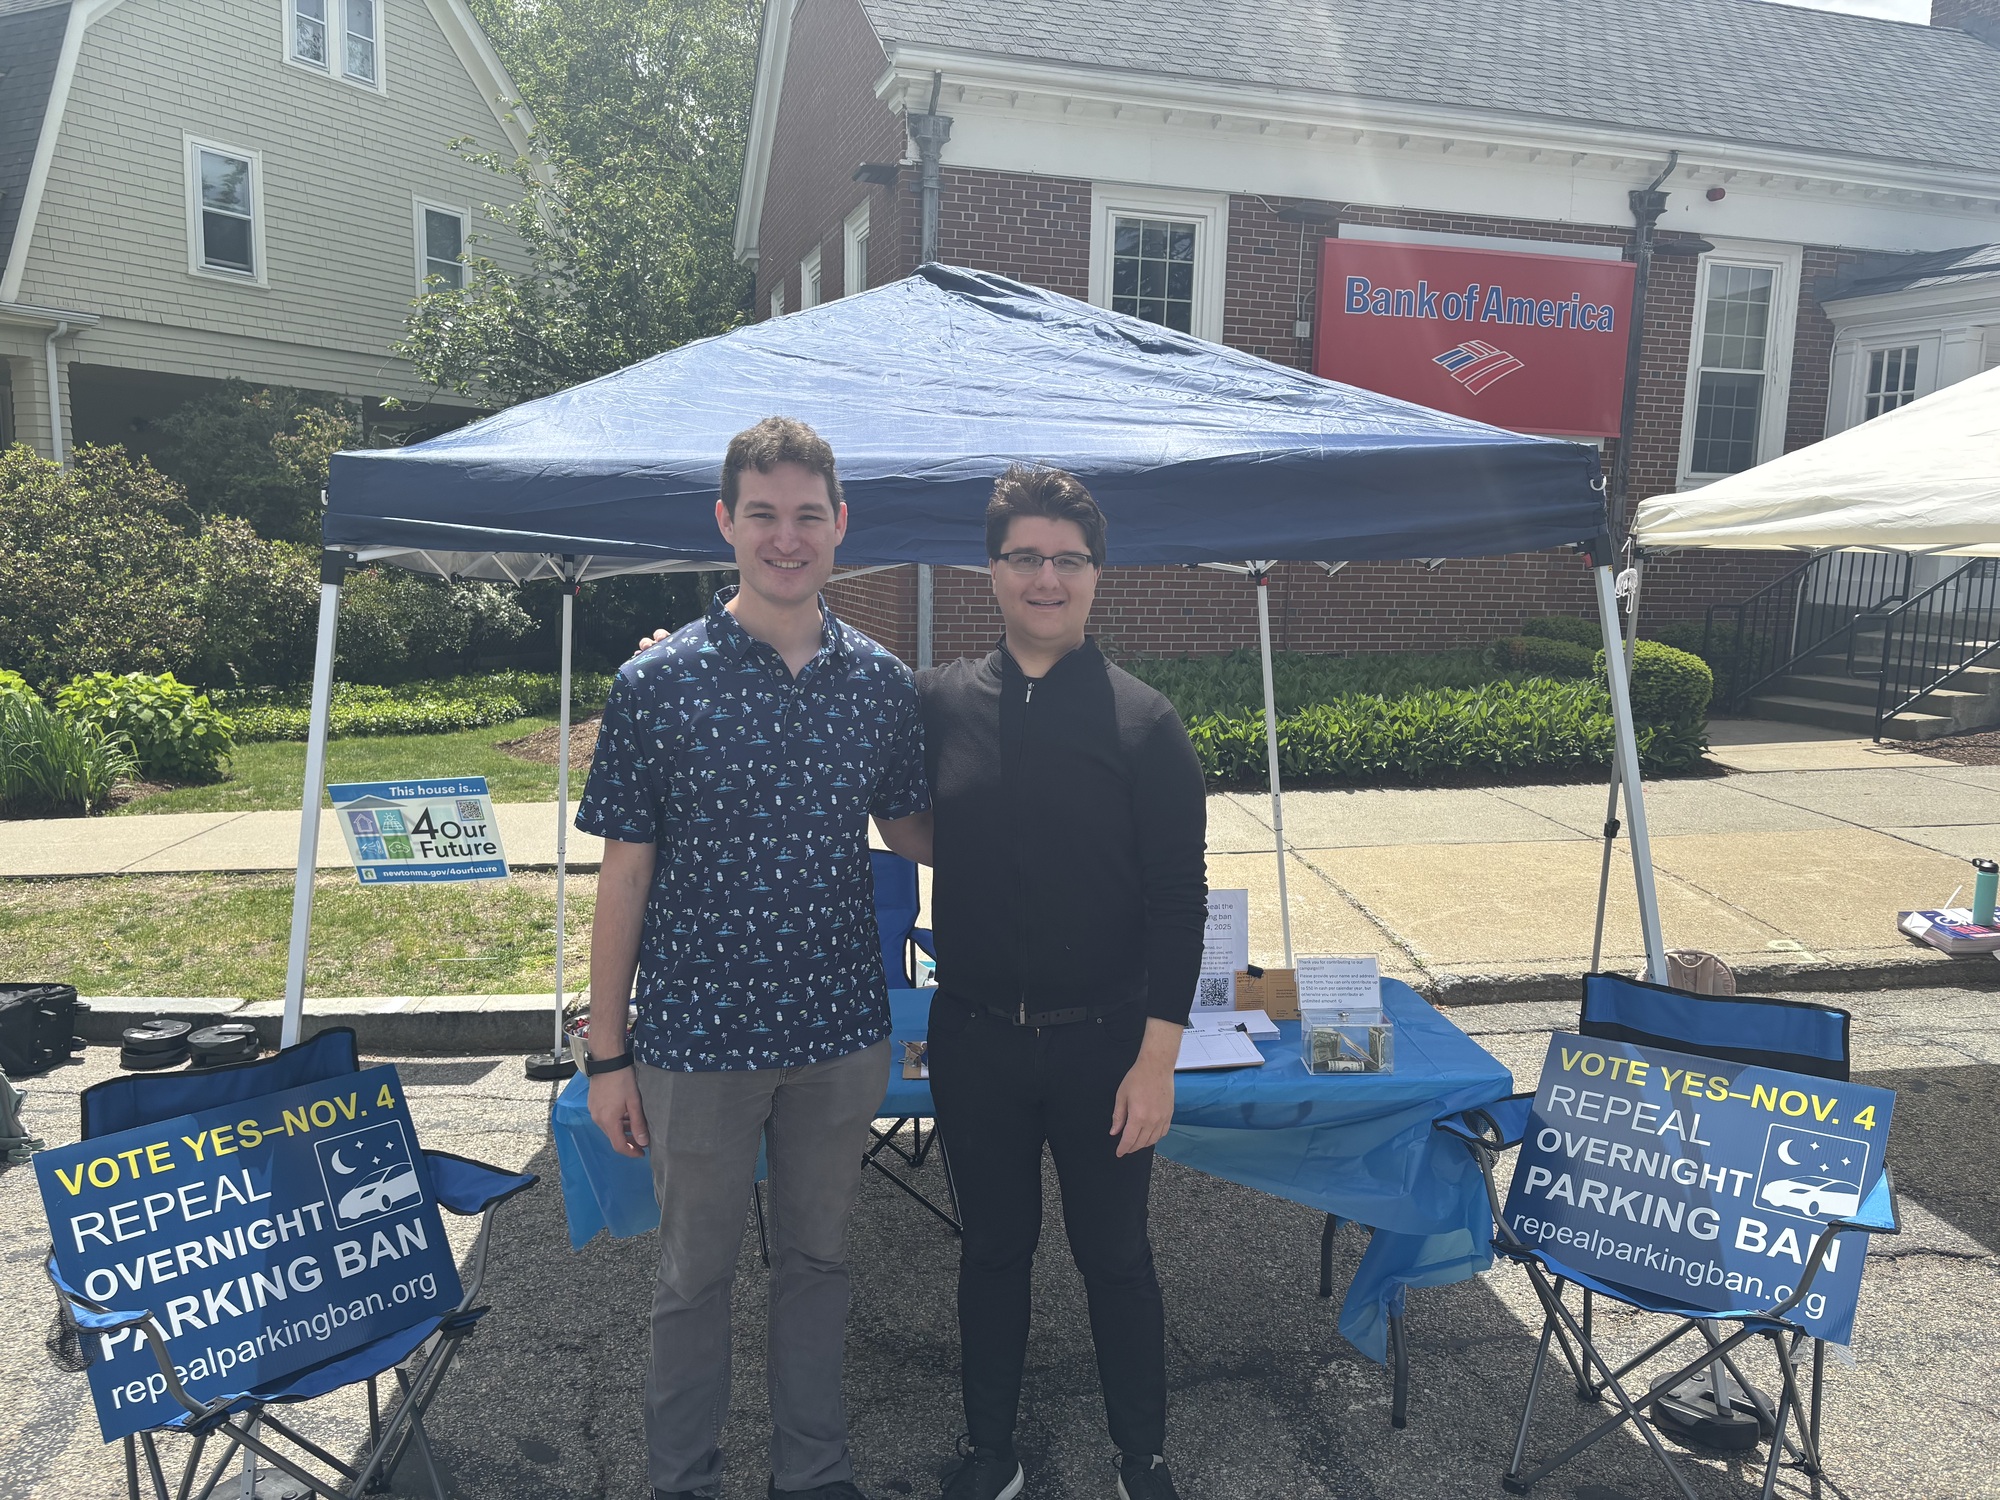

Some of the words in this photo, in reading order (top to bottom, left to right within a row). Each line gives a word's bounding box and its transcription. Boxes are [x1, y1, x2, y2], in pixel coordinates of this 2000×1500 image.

[1345, 276, 1440, 319] Bank
[1442, 284, 1479, 321] of
[1480, 286, 1614, 332] America
[389, 787, 415, 797] This
[418, 785, 455, 796] house
[459, 783, 481, 793] is...
[383, 865, 498, 878] newtonma.gov/4ourfuture
[420, 841, 497, 859] Future
[1546, 1084, 1711, 1147] REPEAL
[1560, 1047, 1650, 1087] VOTE
[1853, 1105, 1876, 1131] 4
[55, 1141, 175, 1196] VOTE
[377, 1084, 396, 1110] 4
[1536, 1128, 1754, 1198] OVERNIGHT
[70, 1168, 272, 1254] REPEAL
[334, 1218, 429, 1279] BAN
[1524, 1165, 1720, 1241] PARKING
[1735, 1216, 1842, 1273] BAN
[84, 1200, 327, 1301] OVERNIGHT
[1513, 1212, 1827, 1320] repealparkingban.og
[111, 1272, 438, 1409] repealparkingban.org
